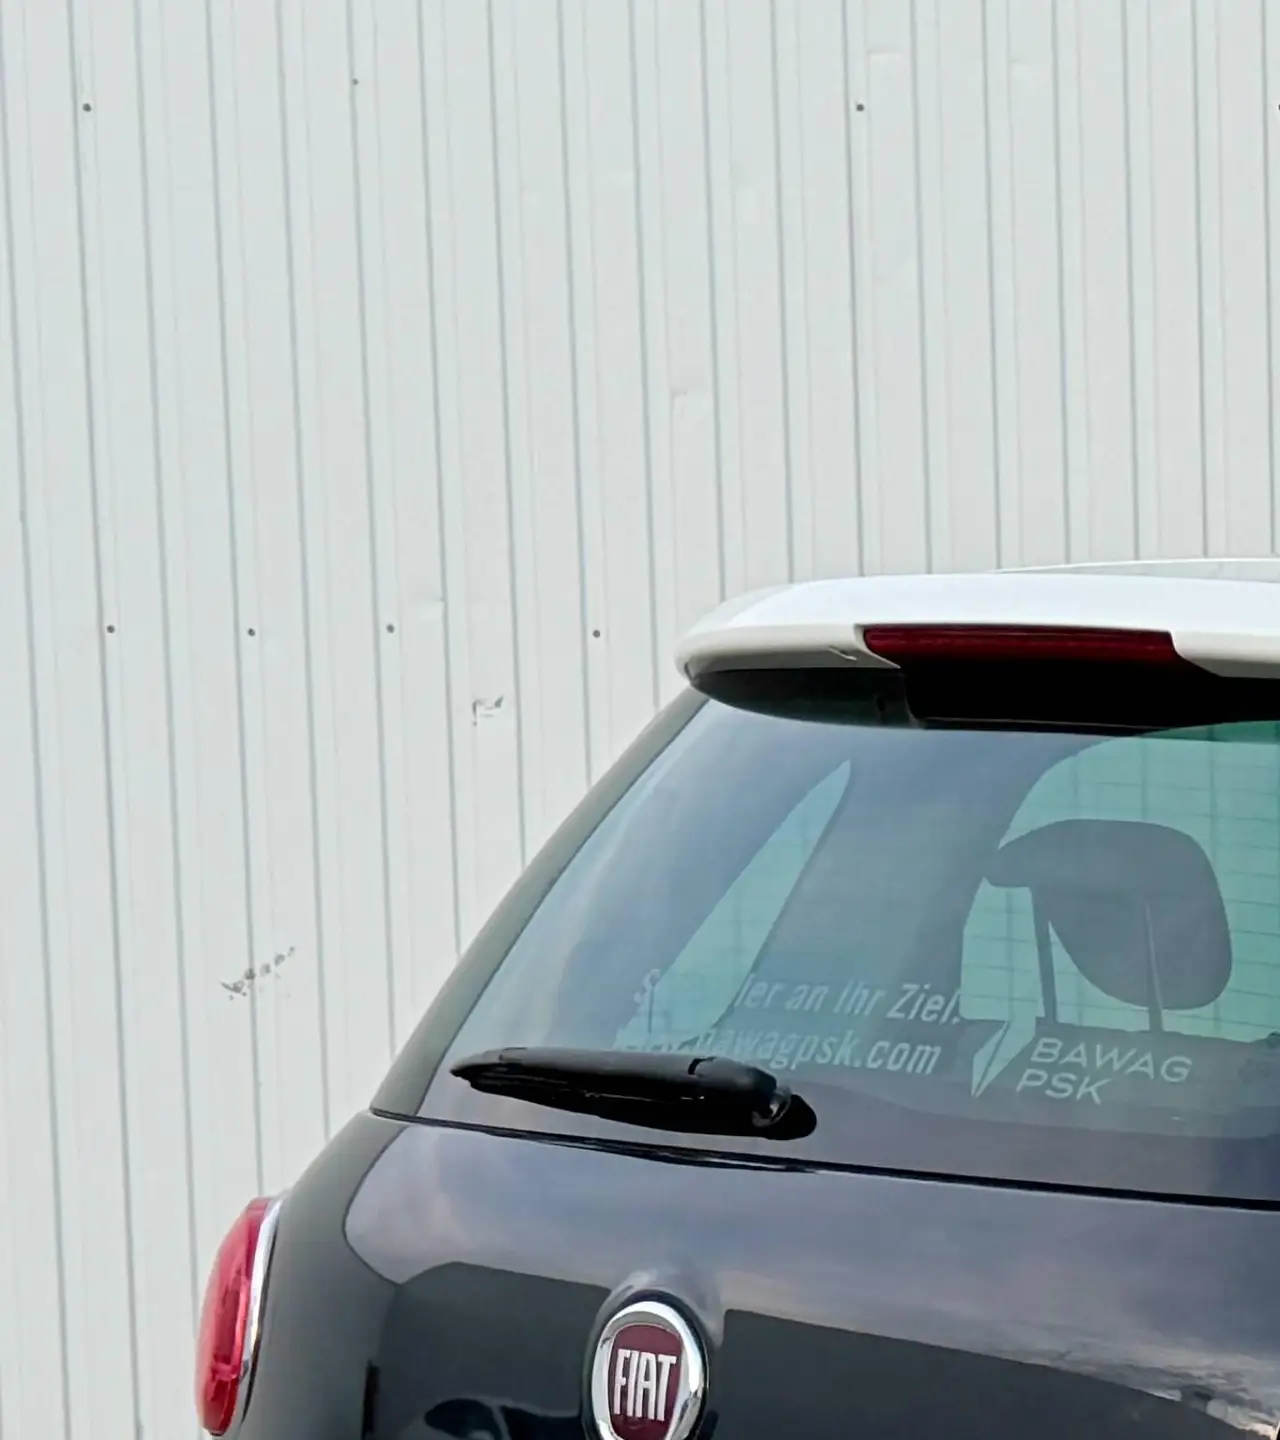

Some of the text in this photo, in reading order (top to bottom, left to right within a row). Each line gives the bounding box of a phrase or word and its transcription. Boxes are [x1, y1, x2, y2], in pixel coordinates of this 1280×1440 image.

[785, 980, 830, 1013] an
[833, 978, 888, 1017] Ihr
[887, 981, 962, 1026] Ziel.
[613, 1026, 942, 1076] awagpsk.com
[1030, 1037, 1193, 1083] BAWAG
[1016, 1068, 1113, 1105] PSK
[612, 1348, 678, 1422] FIAT
